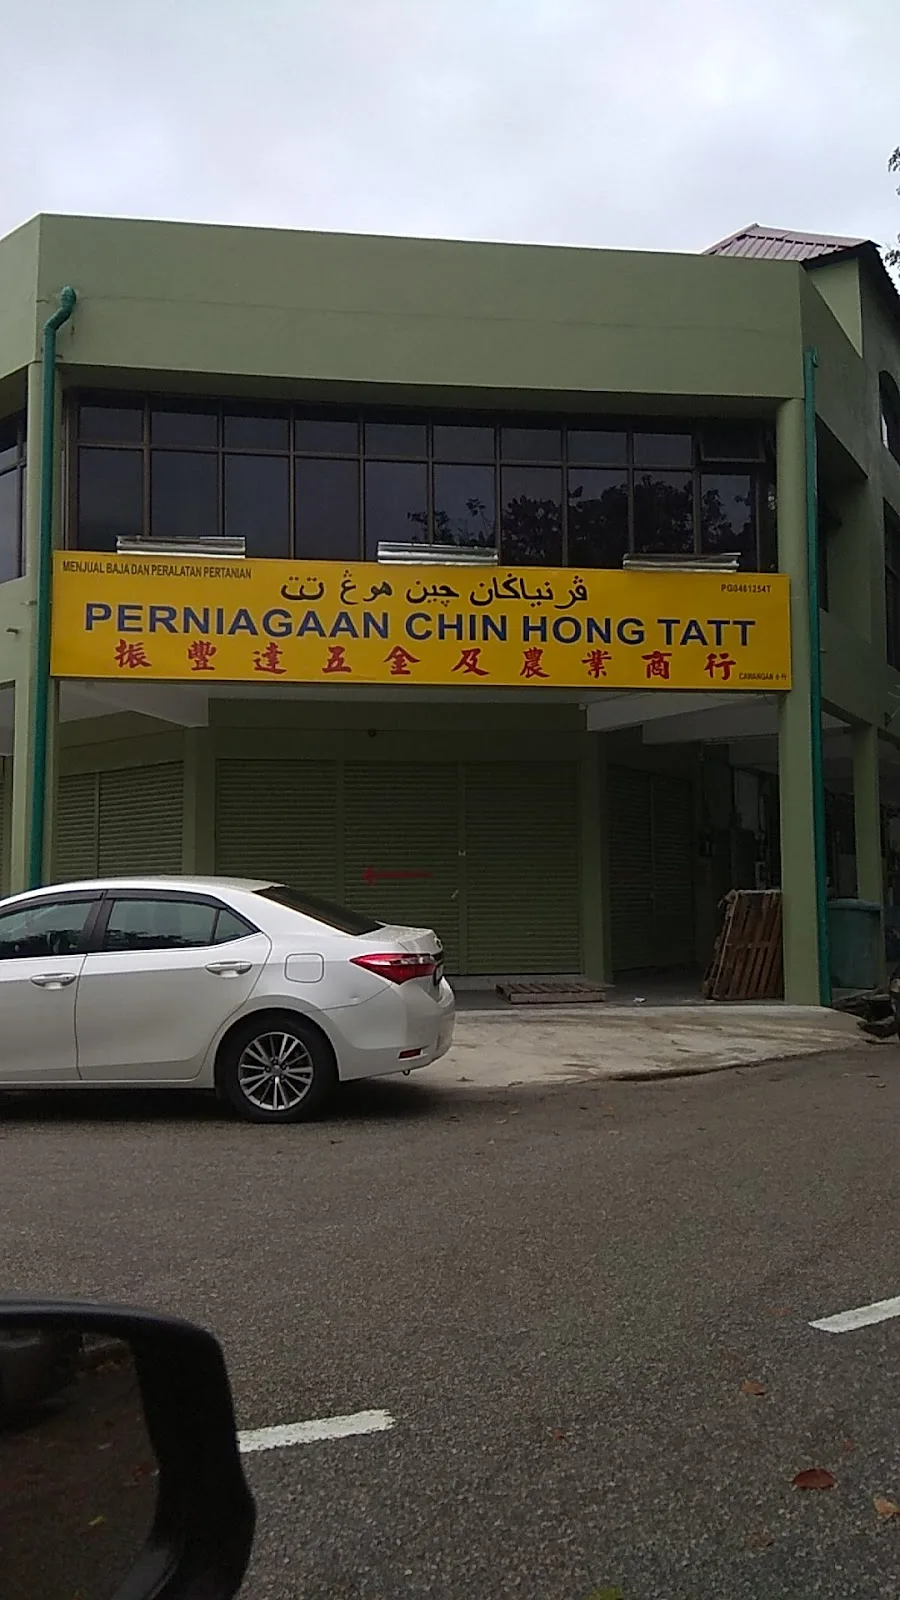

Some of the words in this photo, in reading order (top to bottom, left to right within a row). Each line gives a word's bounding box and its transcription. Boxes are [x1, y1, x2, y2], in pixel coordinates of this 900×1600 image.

[63, 560, 104, 573] MENJUAL
[106, 563, 129, 575] BAJA
[132, 564, 150, 576] DAN
[151, 564, 202, 577] PERALATAN
[203, 566, 252, 579] PERTANIAN
[85, 602, 389, 639] PERNIAGAAN
[405, 612, 507, 642] CHIN
[522, 615, 645, 645] HONG
[657, 619, 756, 646] TATT
